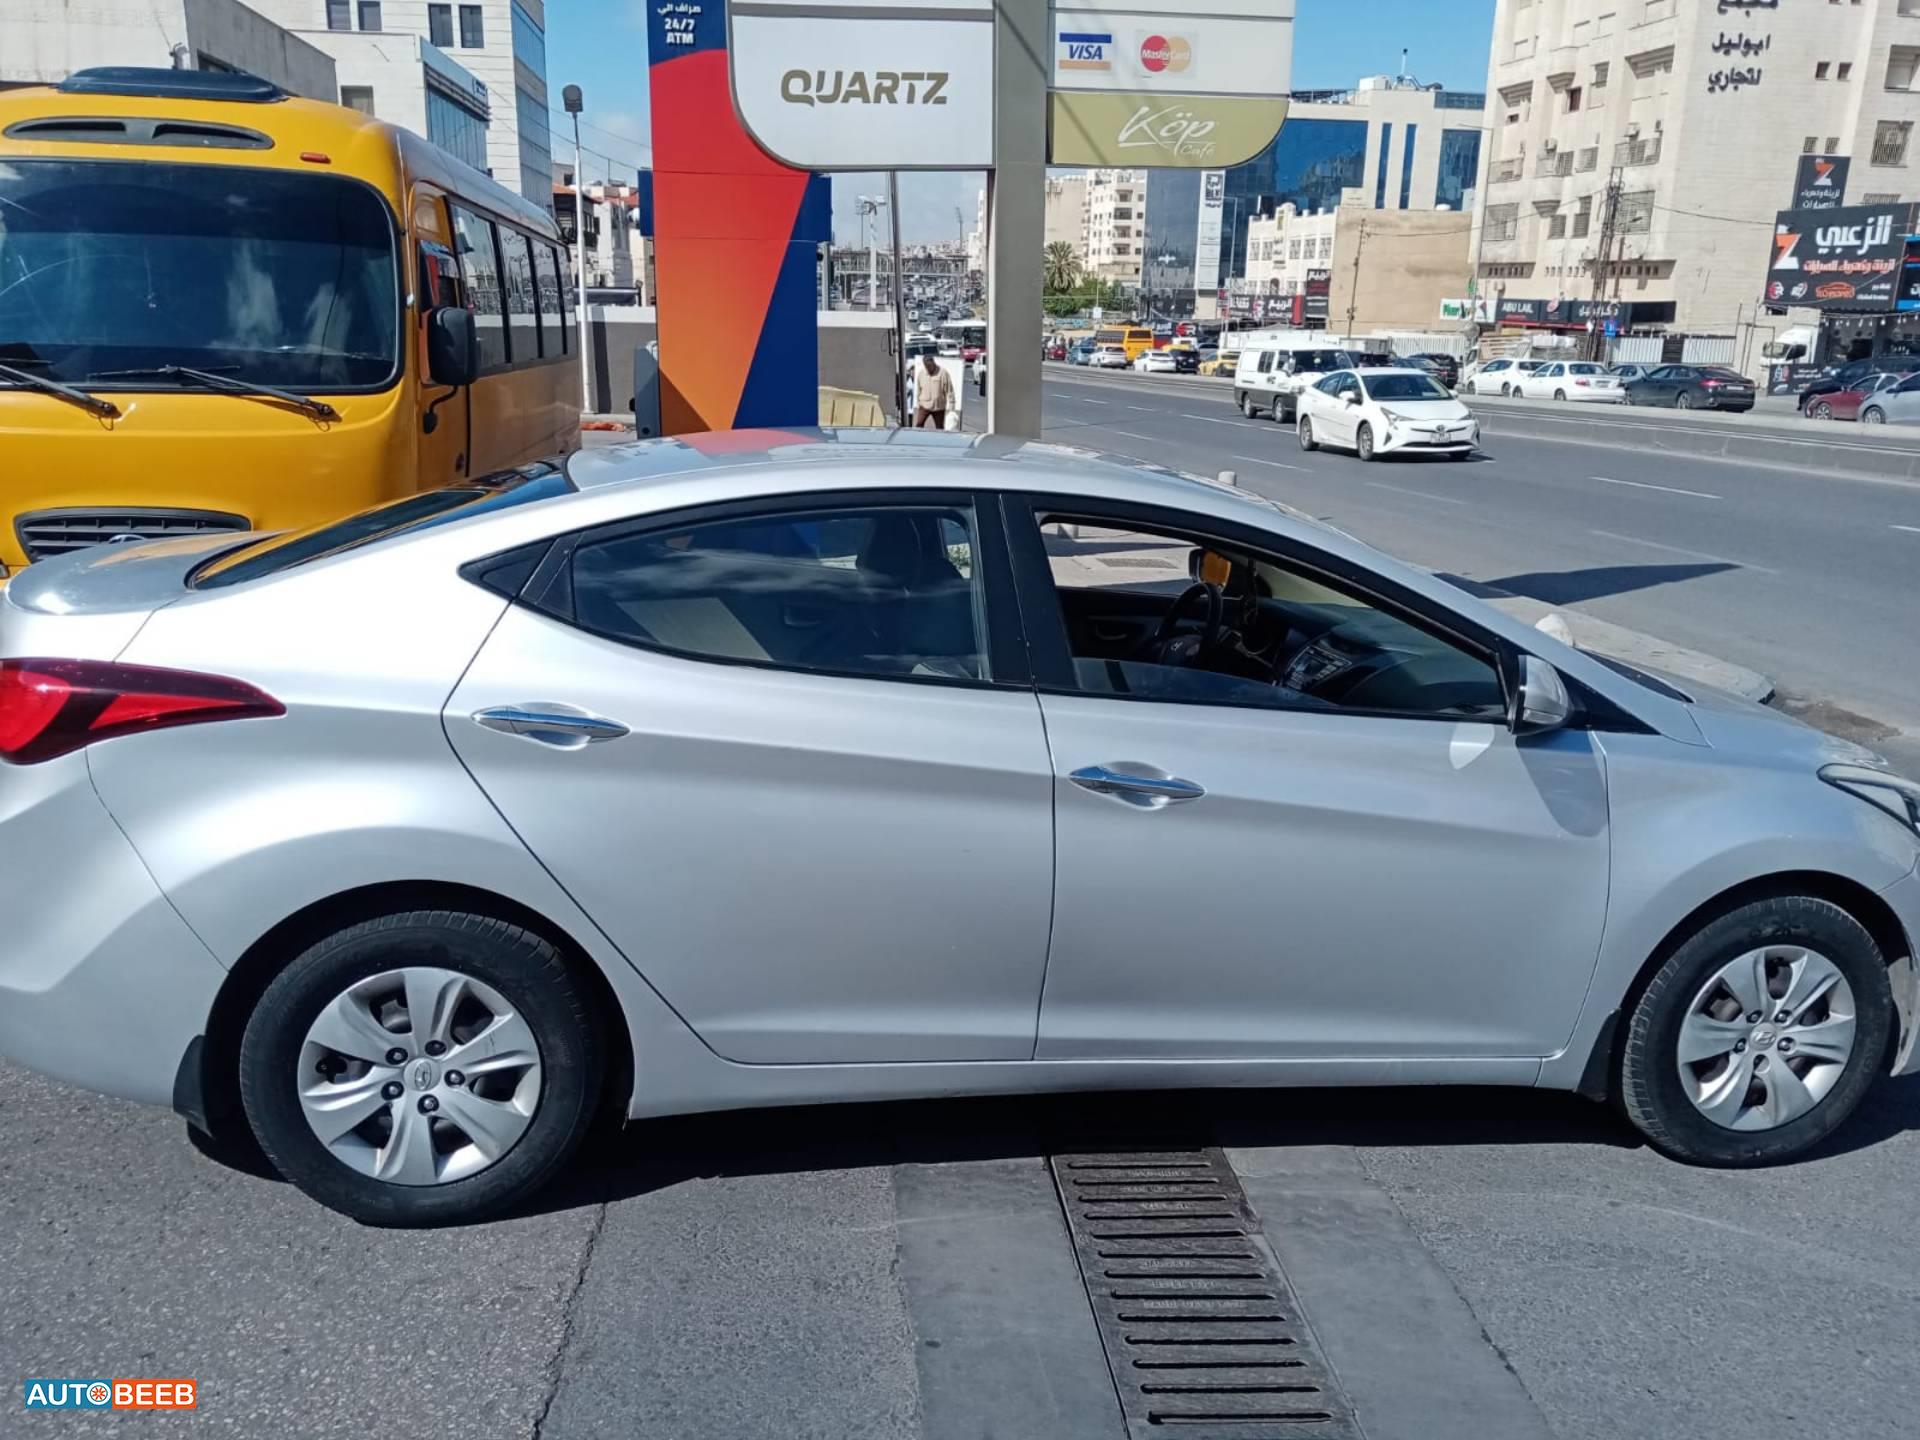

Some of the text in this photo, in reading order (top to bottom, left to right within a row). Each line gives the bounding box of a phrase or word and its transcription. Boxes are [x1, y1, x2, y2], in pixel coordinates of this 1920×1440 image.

[664, 18, 695, 31] 24/7
[666, 32, 694, 44] ATM
[1068, 44, 1103, 60] VISA
[1142, 48, 1190, 60] MasterCard
[781, 69, 949, 107] QUARTZ
[1815, 215, 1893, 255] الزعبي
